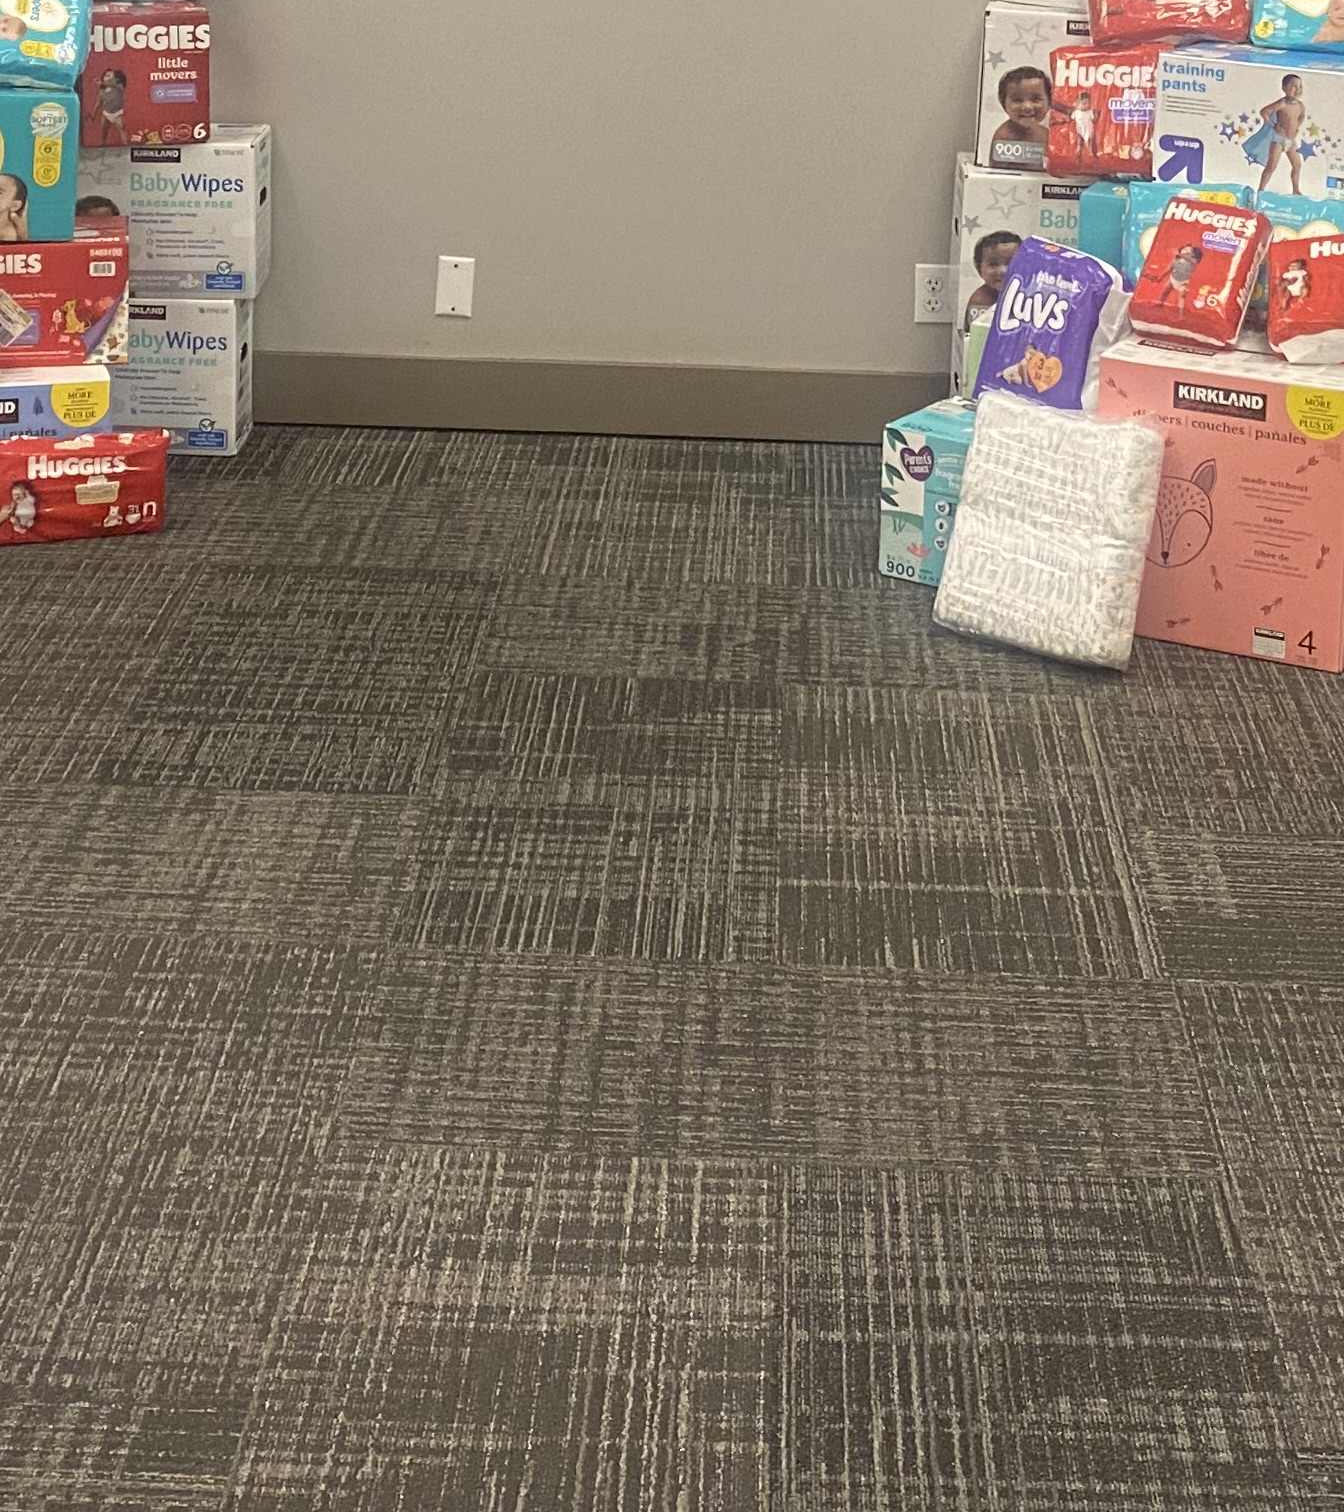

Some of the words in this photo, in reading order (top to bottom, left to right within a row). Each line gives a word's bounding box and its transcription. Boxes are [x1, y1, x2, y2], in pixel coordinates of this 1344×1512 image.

[89, 23, 210, 53] HUGGIES
[157, 57, 188, 68] little
[150, 71, 197, 80] movers
[1055, 59, 1157, 88] HUGGIE
[1162, 61, 1225, 81] training
[1162, 79, 1207, 93] pants
[193, 123, 207, 139] 6
[133, 149, 179, 159] KIRKLAND
[996, 143, 1022, 156] 900
[130, 200, 201, 209] FRAGRANCE
[204, 200, 233, 209] FREE
[1040, 208, 1078, 229] Bab
[1164, 202, 1258, 237] HUGGIES
[1206, 293, 1218, 306] 6
[188, 357, 217, 366] FREE
[1179, 384, 1263, 410] KIRKLAND
[1304, 397, 1332, 409] MORE
[1191, 420, 1245, 436] couches
[1254, 428, 1307, 445] pañales
[27, 456, 127, 479] HUGGIES
[886, 561, 915, 578] 900
[1298, 630, 1317, 655] 4
